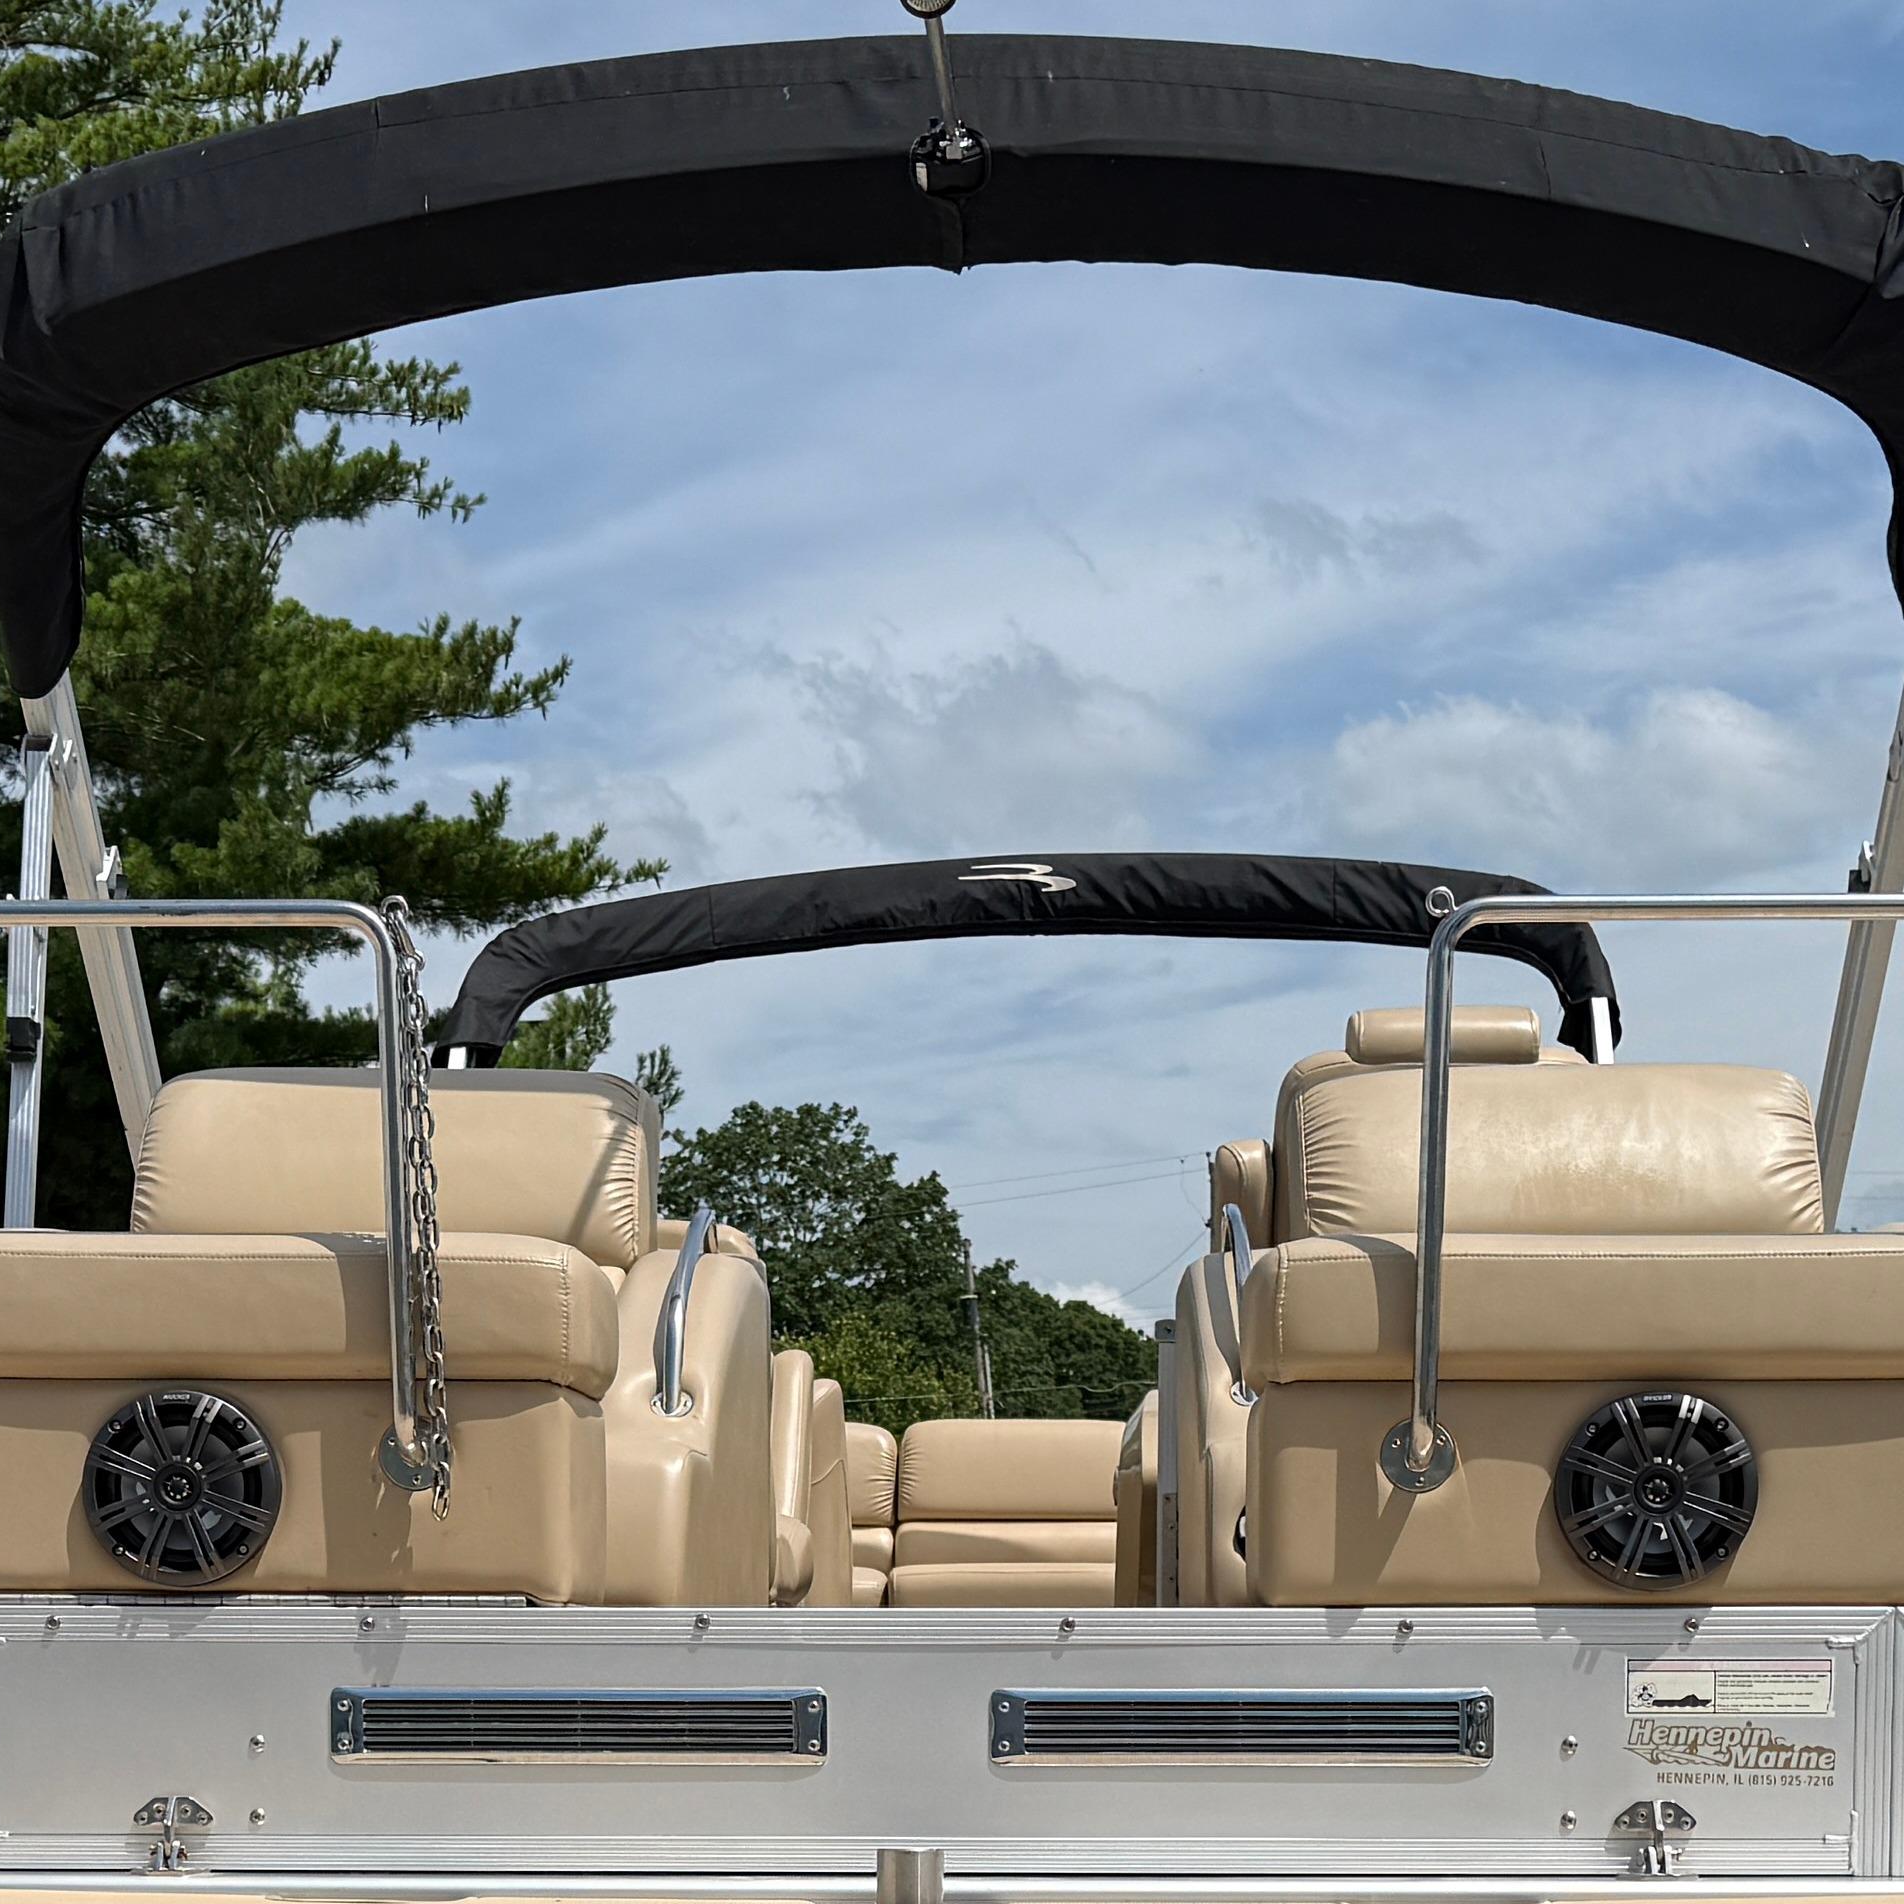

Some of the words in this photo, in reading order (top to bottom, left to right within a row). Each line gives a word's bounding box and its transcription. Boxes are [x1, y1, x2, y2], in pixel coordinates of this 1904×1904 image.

[1627, 1718, 1772, 1752] Hennepin
[1733, 1745, 1836, 1770] Marine
[1657, 1772, 1729, 1786] HENNEPIN,
[1734, 1773, 1744, 1786] IL
[1748, 1773, 1777, 1787] (815)
